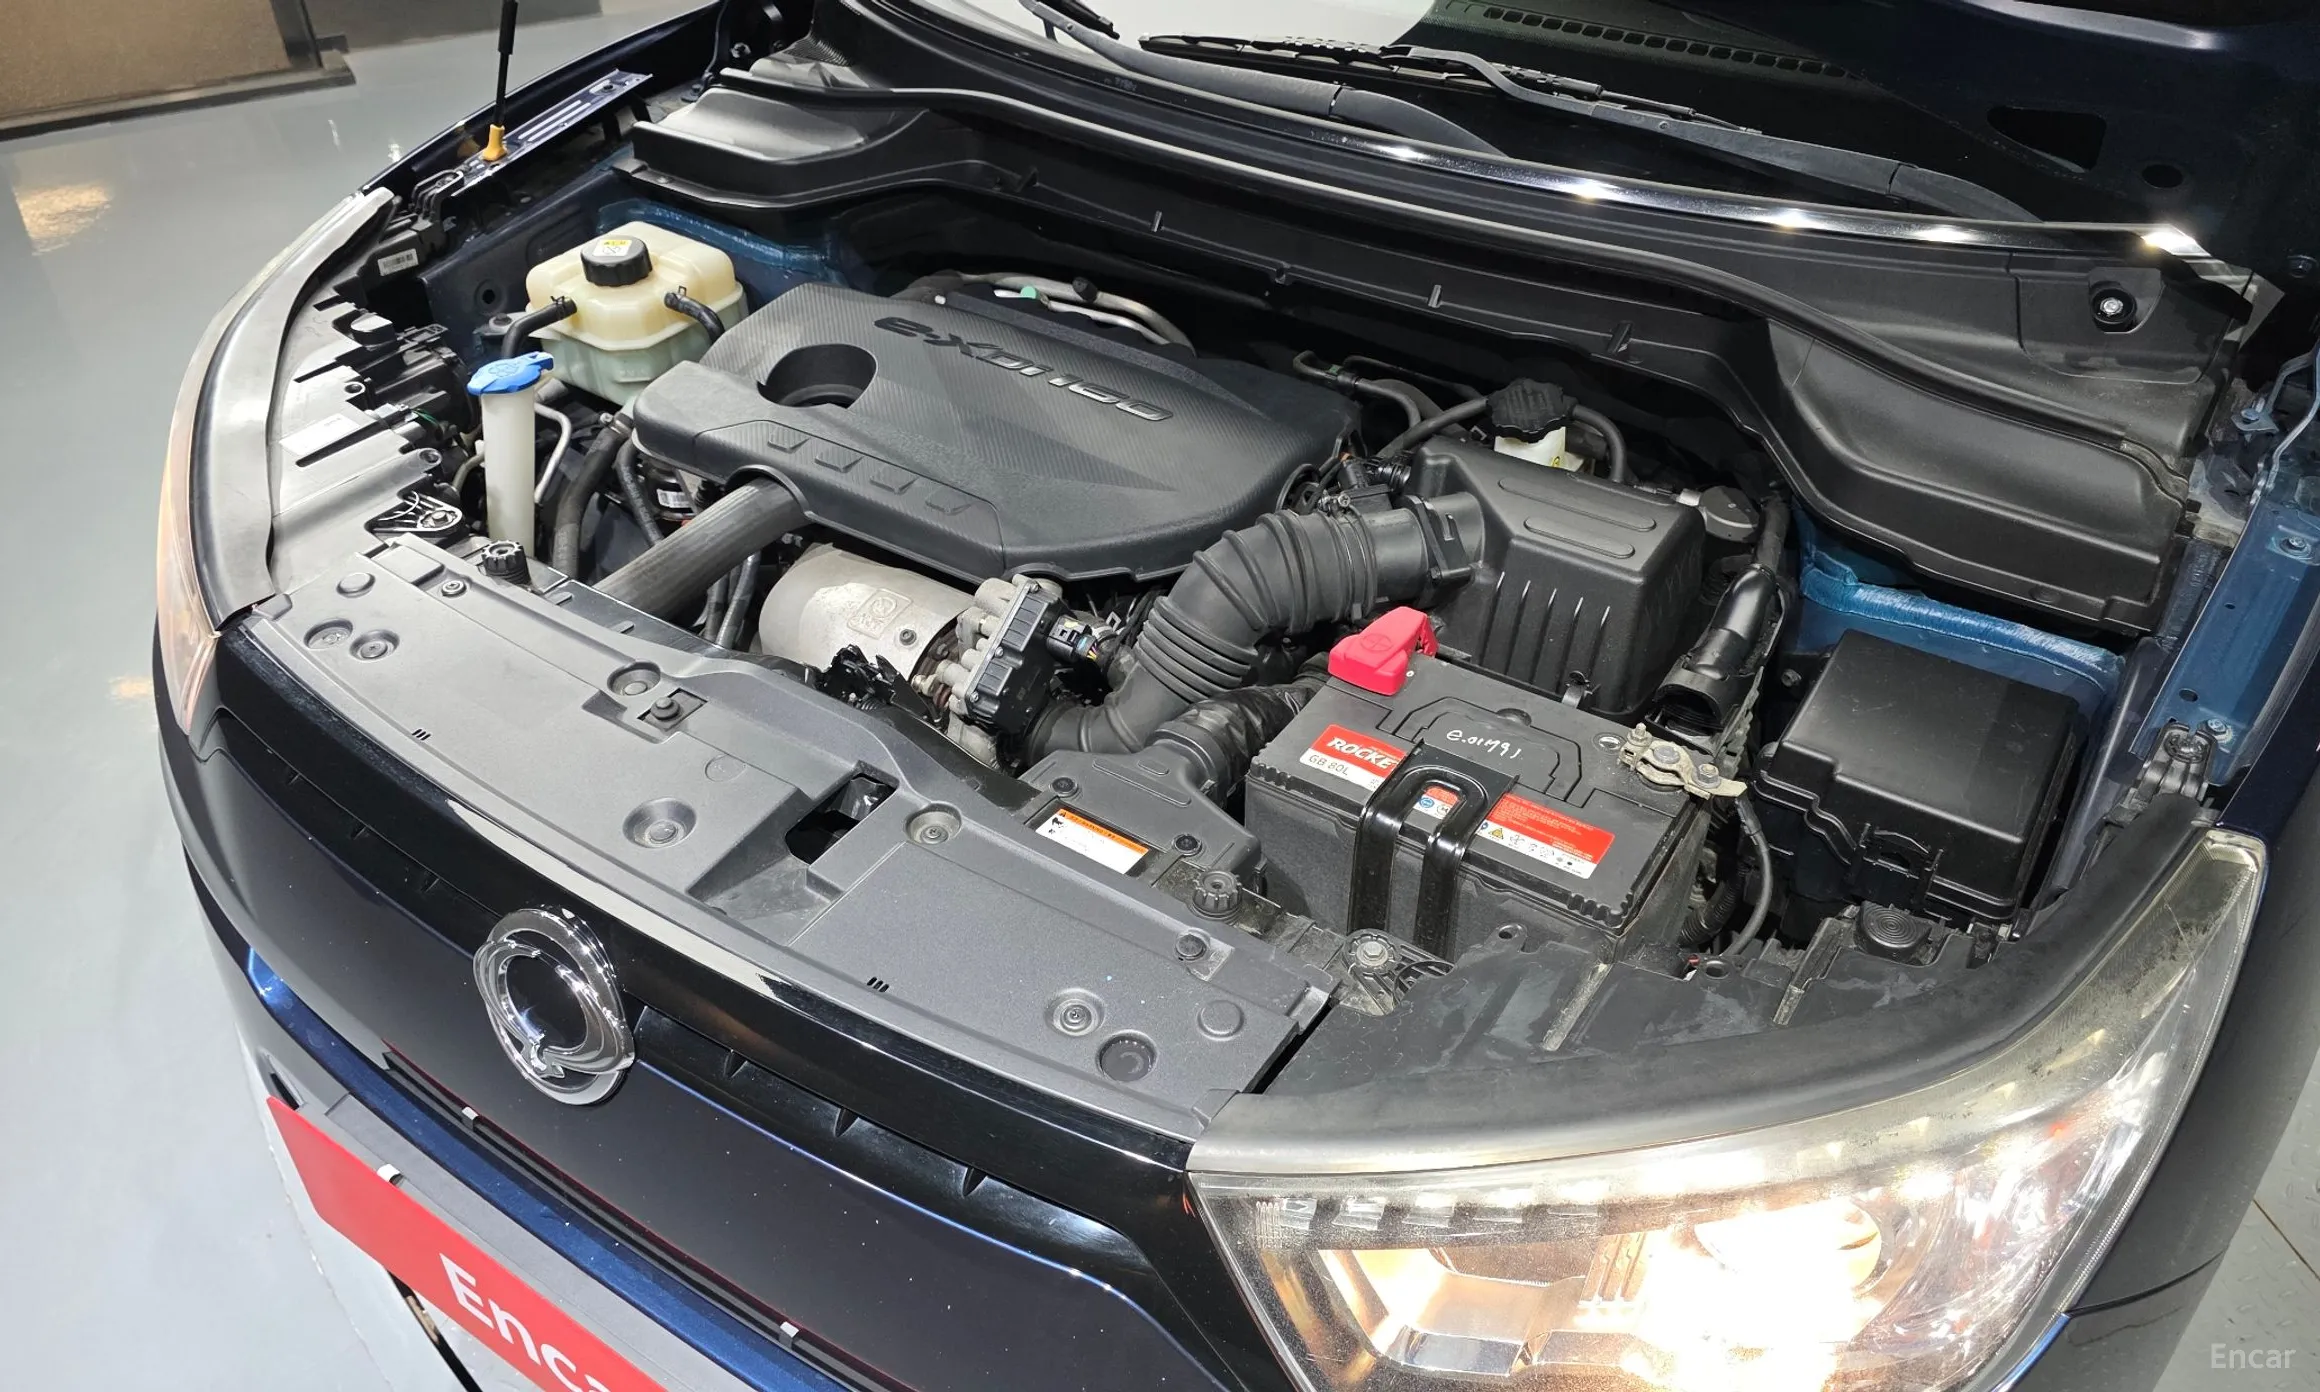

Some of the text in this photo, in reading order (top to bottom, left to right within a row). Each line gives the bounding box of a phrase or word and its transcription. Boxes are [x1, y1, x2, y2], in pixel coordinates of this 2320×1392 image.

[1309, 754, 1348, 776] GB 80L
[1327, 736, 1400, 769] ROCKE
